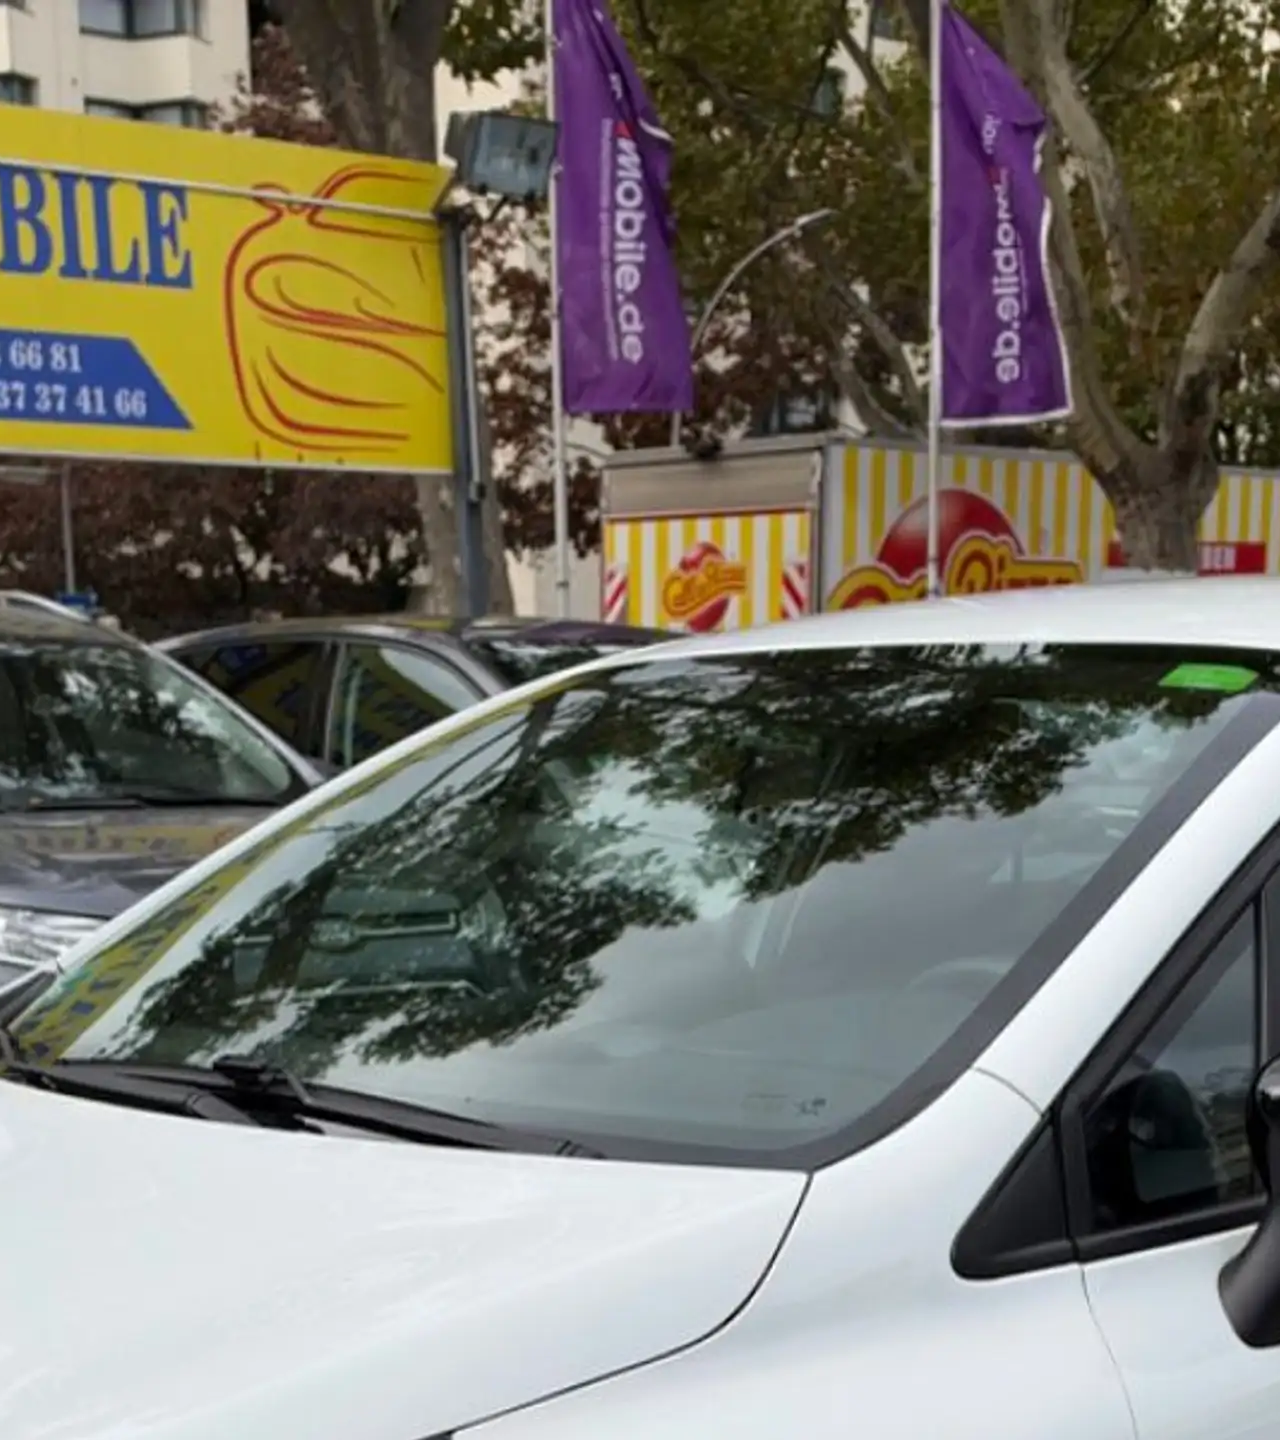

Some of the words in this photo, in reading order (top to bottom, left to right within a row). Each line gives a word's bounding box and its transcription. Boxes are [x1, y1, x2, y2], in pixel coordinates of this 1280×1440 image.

[615, 136, 645, 364] mobile.de
[9, 339, 44, 370] 66
[49, 343, 82, 372] 81
[35, 382, 67, 413] 37
[75, 386, 106, 415] 41
[114, 388, 147, 418] 66
